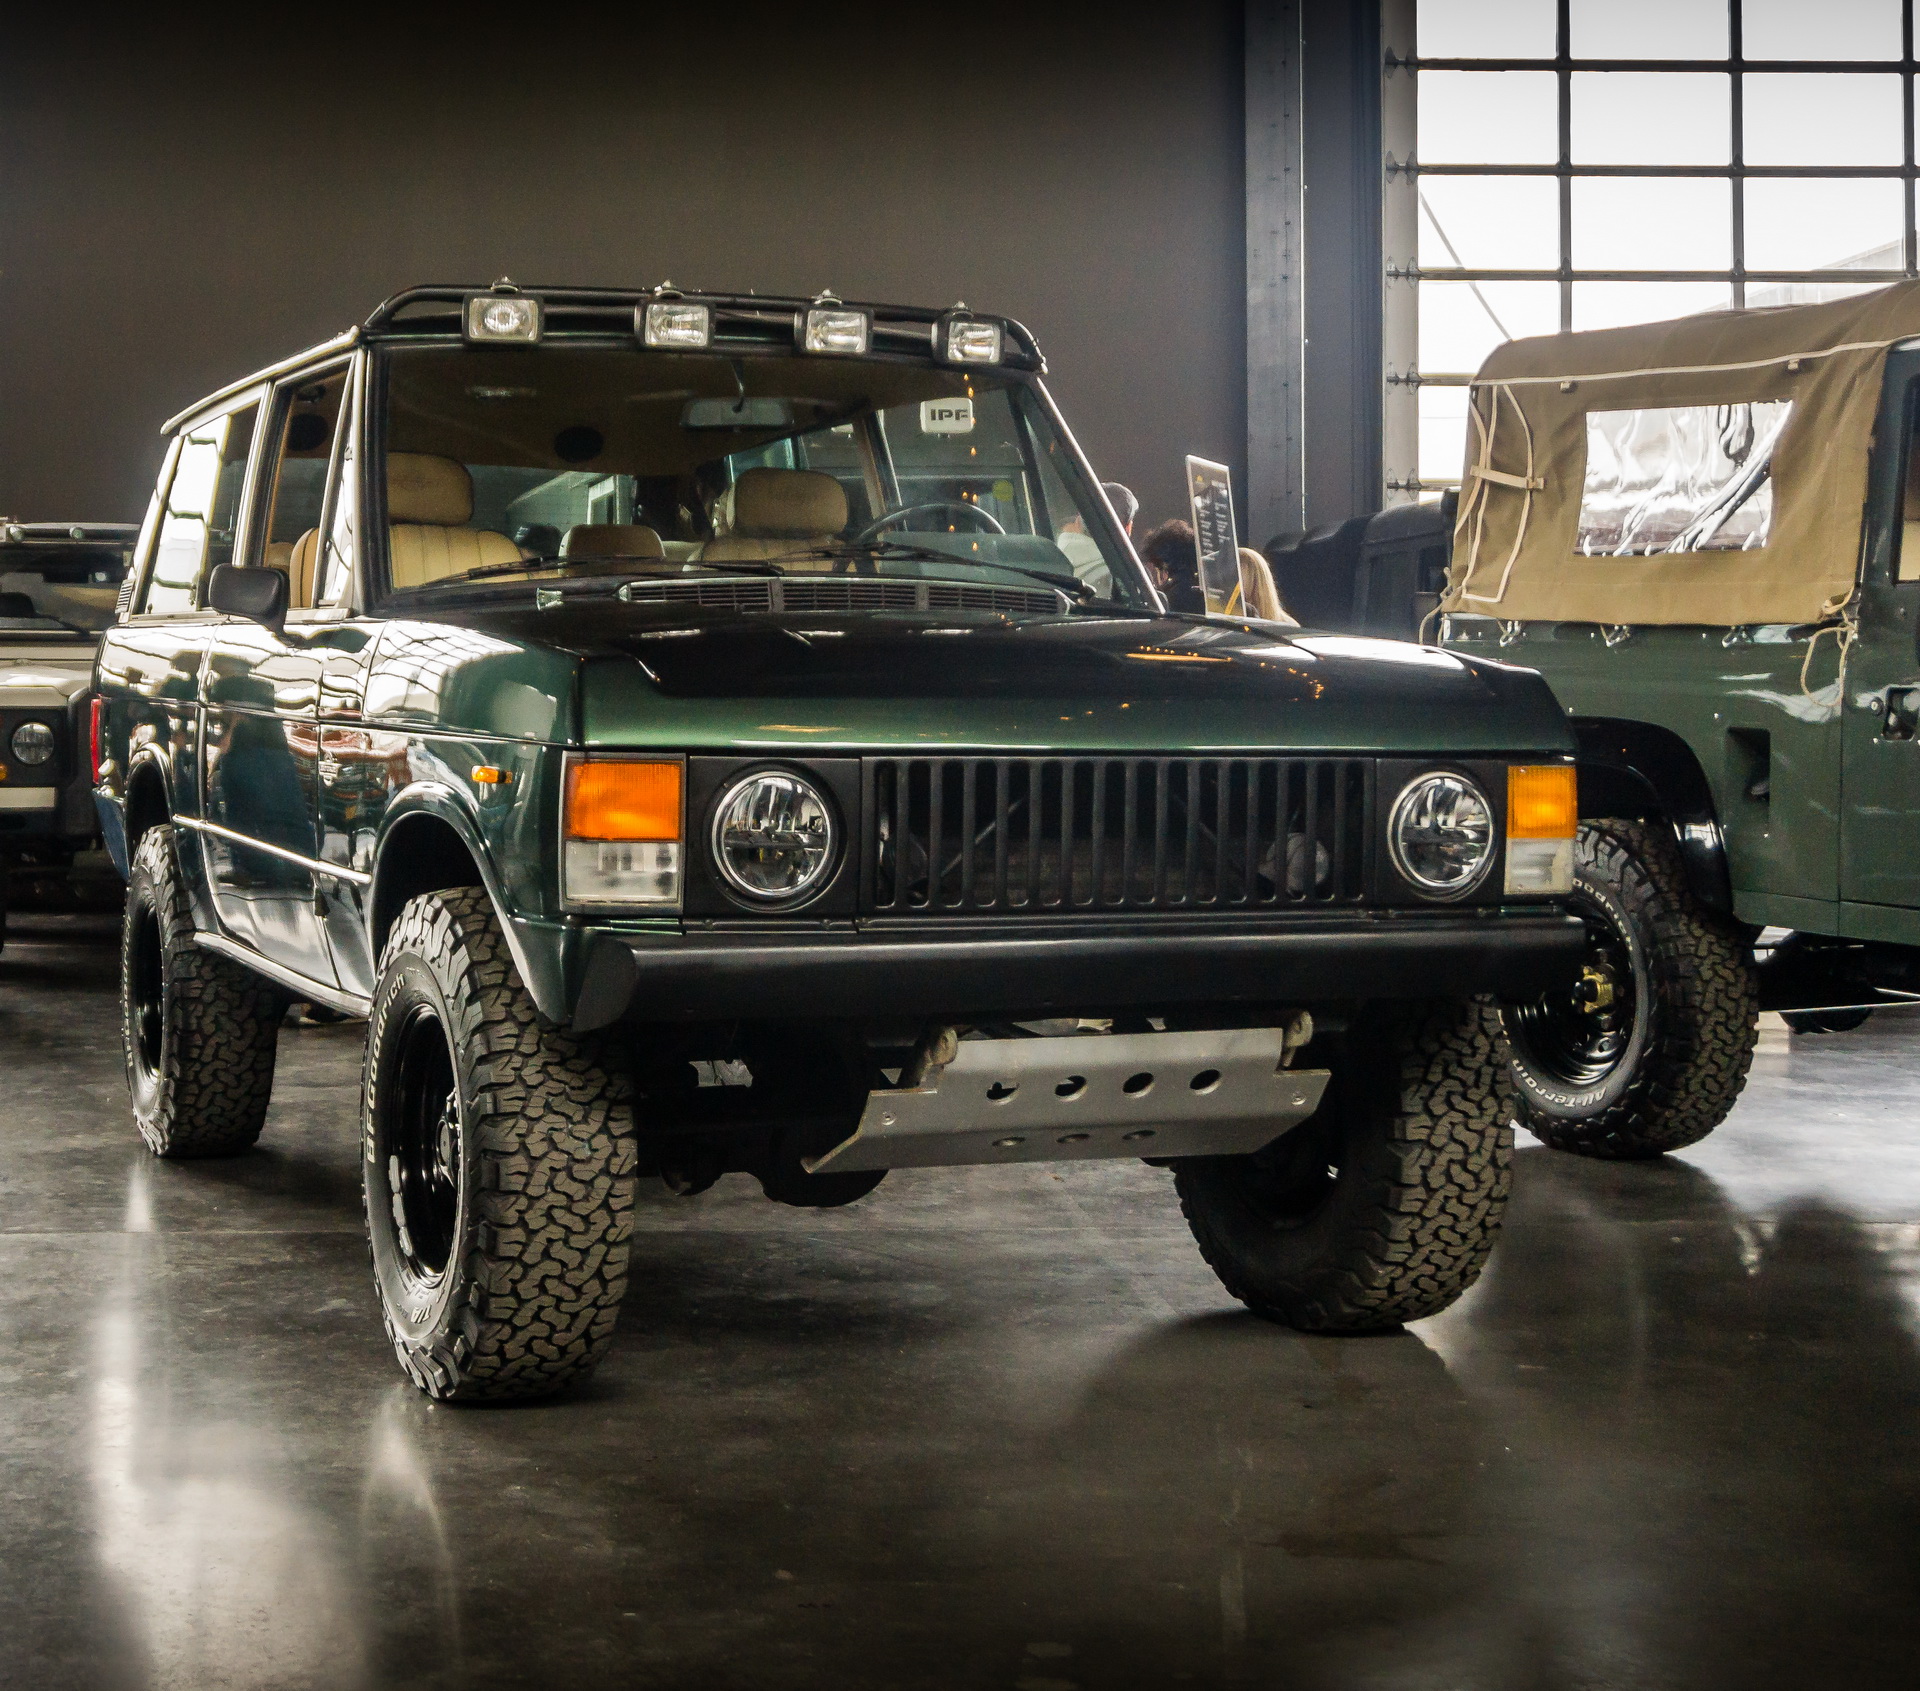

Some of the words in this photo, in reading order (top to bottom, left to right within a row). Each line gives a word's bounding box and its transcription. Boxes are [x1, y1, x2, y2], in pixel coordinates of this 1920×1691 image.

[930, 408, 969, 421] IPF
[1572, 877, 1633, 951] oodrich
[366, 972, 405, 1164] BFGoodrich
[1512, 1059, 1607, 1108] All-Terrain
[410, 1303, 432, 1324] T/A
